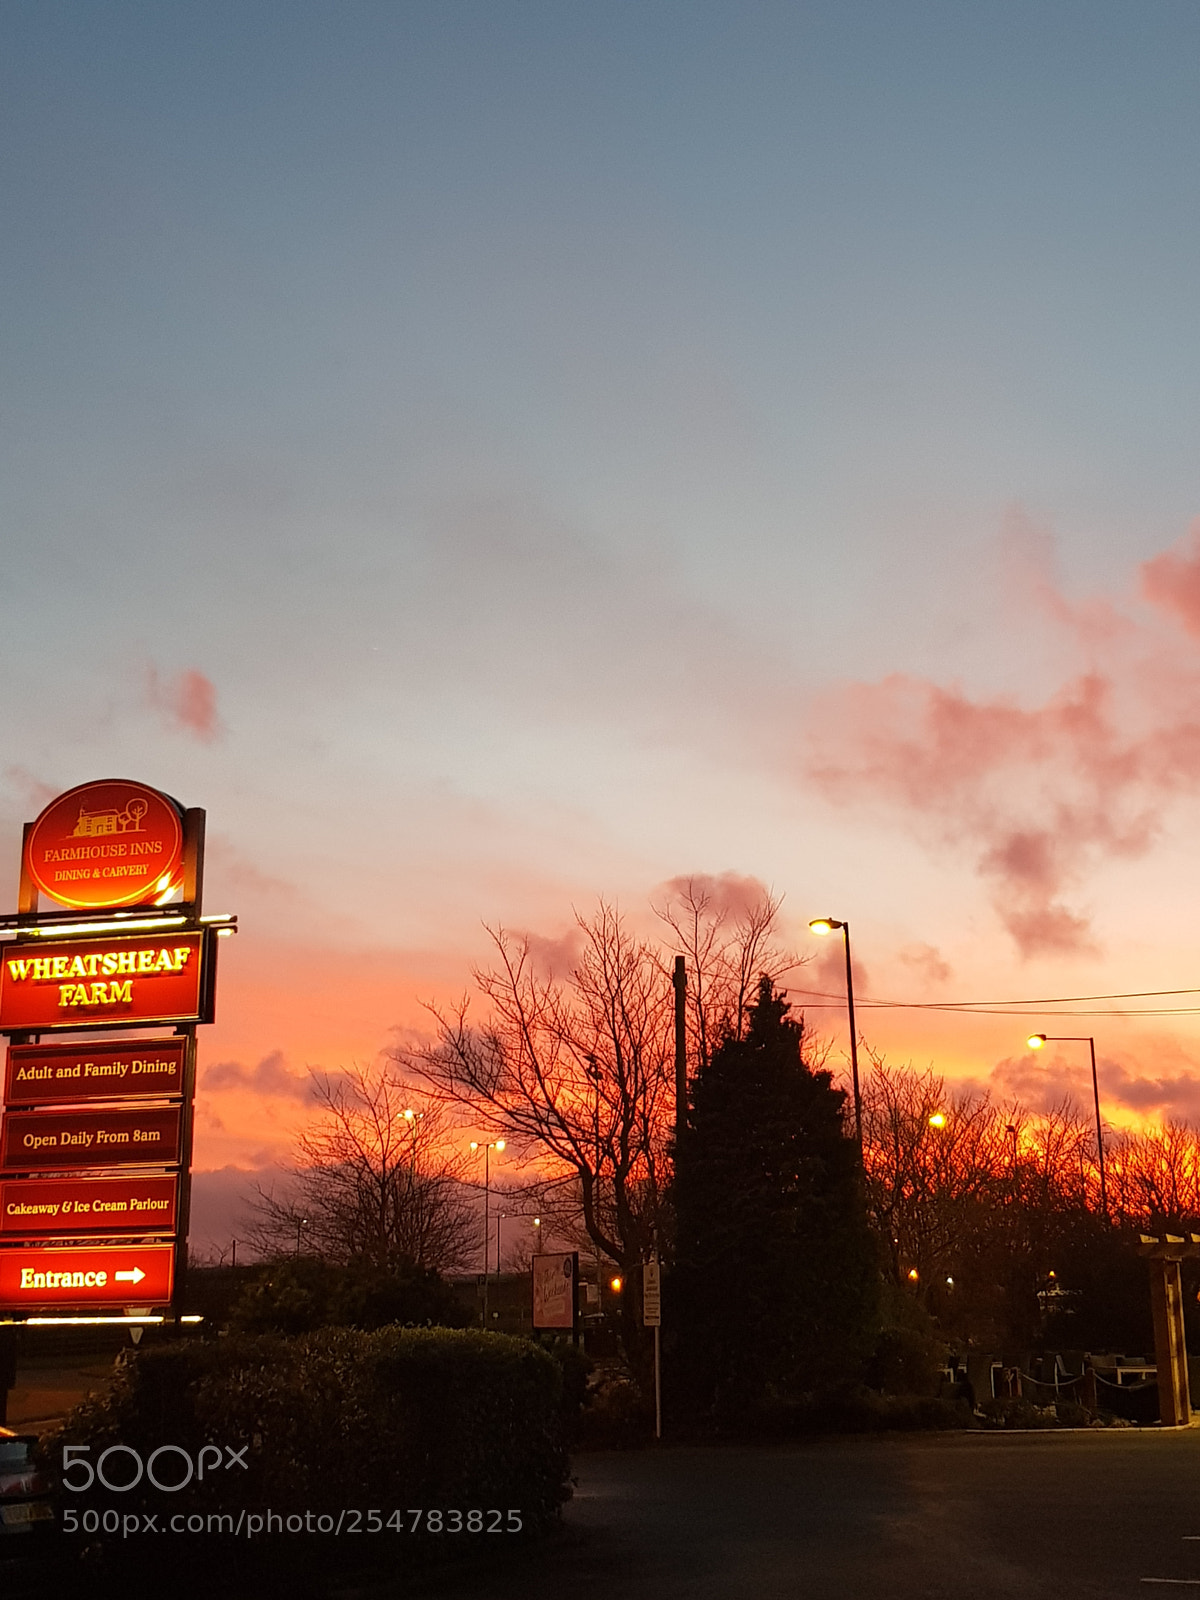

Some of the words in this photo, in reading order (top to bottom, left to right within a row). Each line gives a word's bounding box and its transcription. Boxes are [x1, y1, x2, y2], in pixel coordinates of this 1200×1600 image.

[44, 844, 127, 862] FARMHOUSE
[130, 841, 163, 855] INNS
[54, 867, 91, 881] DINING
[92, 868, 101, 879] &
[102, 864, 149, 878] CARVERY
[7, 947, 190, 981] WHEATSHEAF
[58, 980, 133, 1006] FARM
[16, 1065, 53, 1080] Adult
[56, 1064, 81, 1078] and
[84, 1061, 128, 1077] Family
[131, 1059, 177, 1075] Dining
[23, 1133, 57, 1149] Open
[60, 1132, 94, 1147] Daily
[96, 1130, 130, 1144] From
[133, 1129, 161, 1142] 8am
[7, 1201, 60, 1216] Cakeaway
[61, 1201, 72, 1213] &
[74, 1200, 90, 1212] Ice
[92, 1199, 127, 1212] Cream
[129, 1196, 169, 1211] Parlour
[20, 1267, 107, 1288] Entrance
